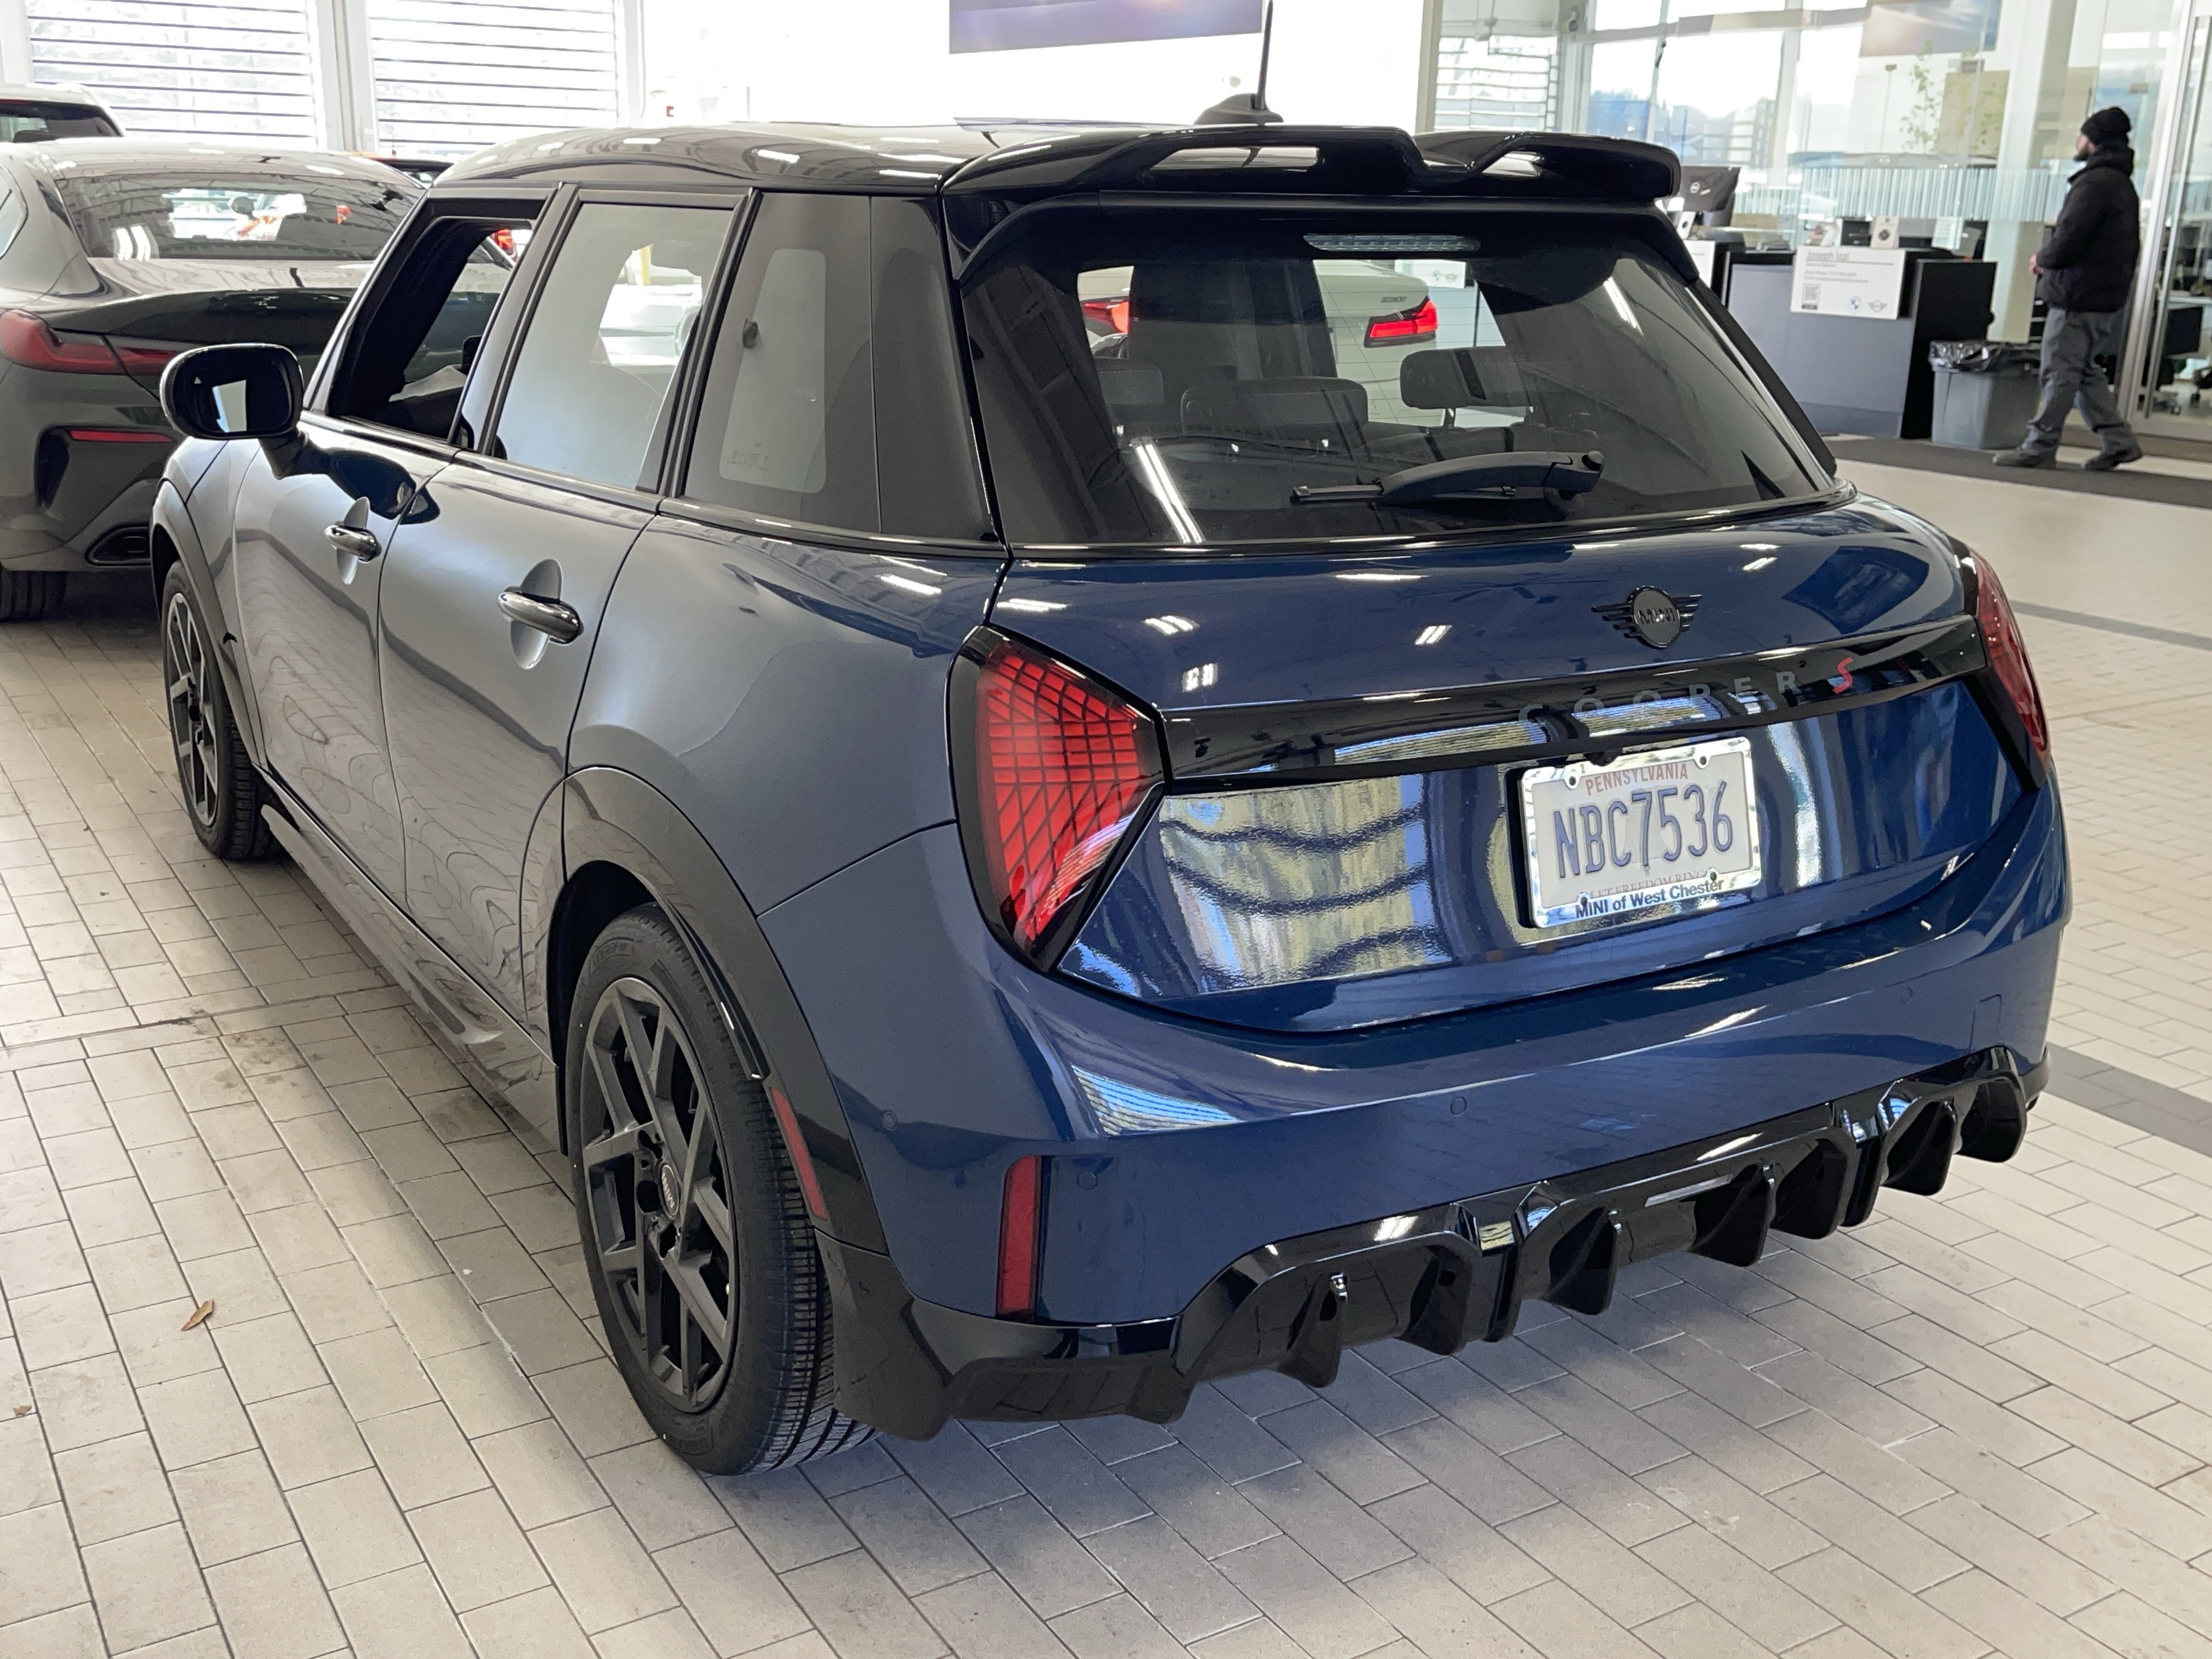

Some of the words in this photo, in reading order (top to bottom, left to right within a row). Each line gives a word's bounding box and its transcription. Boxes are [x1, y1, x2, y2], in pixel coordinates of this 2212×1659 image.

[1638, 608, 1675, 624] MINI
[1833, 657, 1853, 694] S
[1585, 763, 1688, 795] PENNSYLVANIA
[1554, 781, 1733, 878] NBC7536
[1575, 899, 1609, 918] MINI
[1612, 895, 1627, 911] of
[1629, 888, 1666, 907] West
[1669, 879, 1724, 899] Chester
